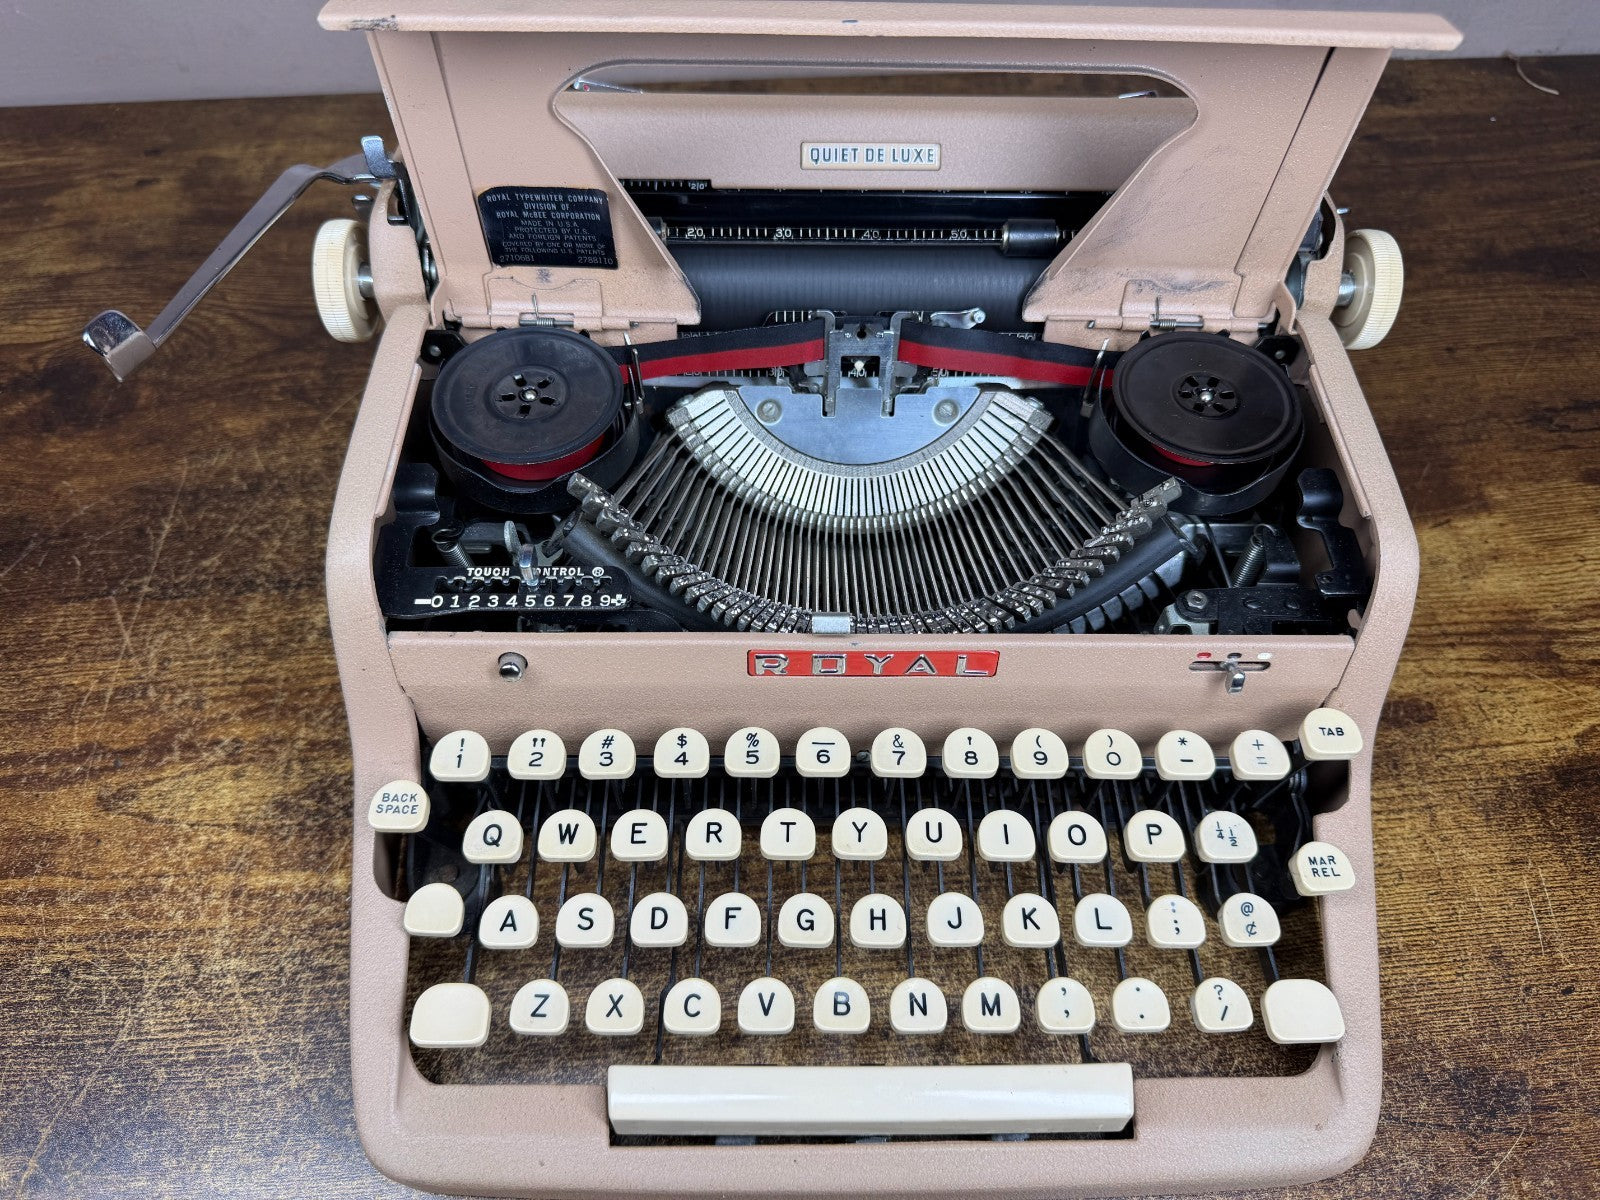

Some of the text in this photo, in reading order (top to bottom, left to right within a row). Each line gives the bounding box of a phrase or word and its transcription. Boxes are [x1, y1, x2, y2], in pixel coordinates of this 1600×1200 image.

[810, 147, 935, 165] QUIET DE LUXE
[486, 193, 603, 205] ROYAL TYPEWRITER COMPANY
[524, 202, 557, 210] DIVISION
[496, 210, 601, 221] ROYAL McBEE CORPORATION
[686, 228, 968, 239] 20 30 40 50
[466, 567, 511, 577] TOUCH
[754, 653, 988, 676] ROYAL
[1318, 726, 1345, 737] TAB
[459, 737, 465, 752] !
[602, 735, 614, 749] #
[676, 733, 688, 748] $
[745, 732, 760, 748] %
[892, 734, 905, 748] &
[1035, 734, 1042, 748] (
[1107, 734, 1113, 748] )
[1252, 739, 1264, 751] +
[456, 754, 463, 768] 1
[528, 752, 544, 767] 2
[599, 751, 614, 766] 3
[674, 751, 689, 766] 4
[745, 750, 760, 765] 5
[816, 749, 831, 764] 6
[892, 750, 906, 766] 7
[964, 750, 979, 765] 8
[1033, 750, 1048, 766] 9
[1106, 751, 1121, 766] 0
[381, 792, 418, 802] BACK
[375, 803, 419, 815] SPACE
[482, 823, 503, 847] Q
[558, 822, 580, 845] W
[630, 822, 648, 845] E
[705, 821, 722, 843] R
[780, 821, 797, 843] T
[851, 821, 868, 843] Y
[925, 821, 943, 843] U
[1002, 823, 1009, 845] I
[1067, 824, 1087, 846] O
[1146, 823, 1163, 845] P
[1308, 855, 1337, 867] MAR
[1312, 867, 1342, 878] REL
[1240, 901, 1255, 917] @
[499, 909, 517, 932] A
[577, 907, 594, 931] S
[650, 906, 668, 930] D
[725, 906, 742, 930] F
[796, 908, 815, 931] G
[869, 908, 887, 931] H
[947, 906, 963, 930] J
[1021, 907, 1041, 930] K
[1094, 907, 1113, 930] L
[1173, 919, 1181, 935] ;
[1245, 921, 1258, 937] ¢
[1213, 983, 1224, 1001] ?
[530, 993, 550, 1018] Z
[605, 993, 624, 1018] X
[683, 993, 701, 1018] C
[757, 992, 776, 1016] V
[833, 991, 851, 1016] B
[909, 992, 928, 1016] N
[980, 992, 1002, 1016] M
[1220, 1005, 1229, 1022] /
